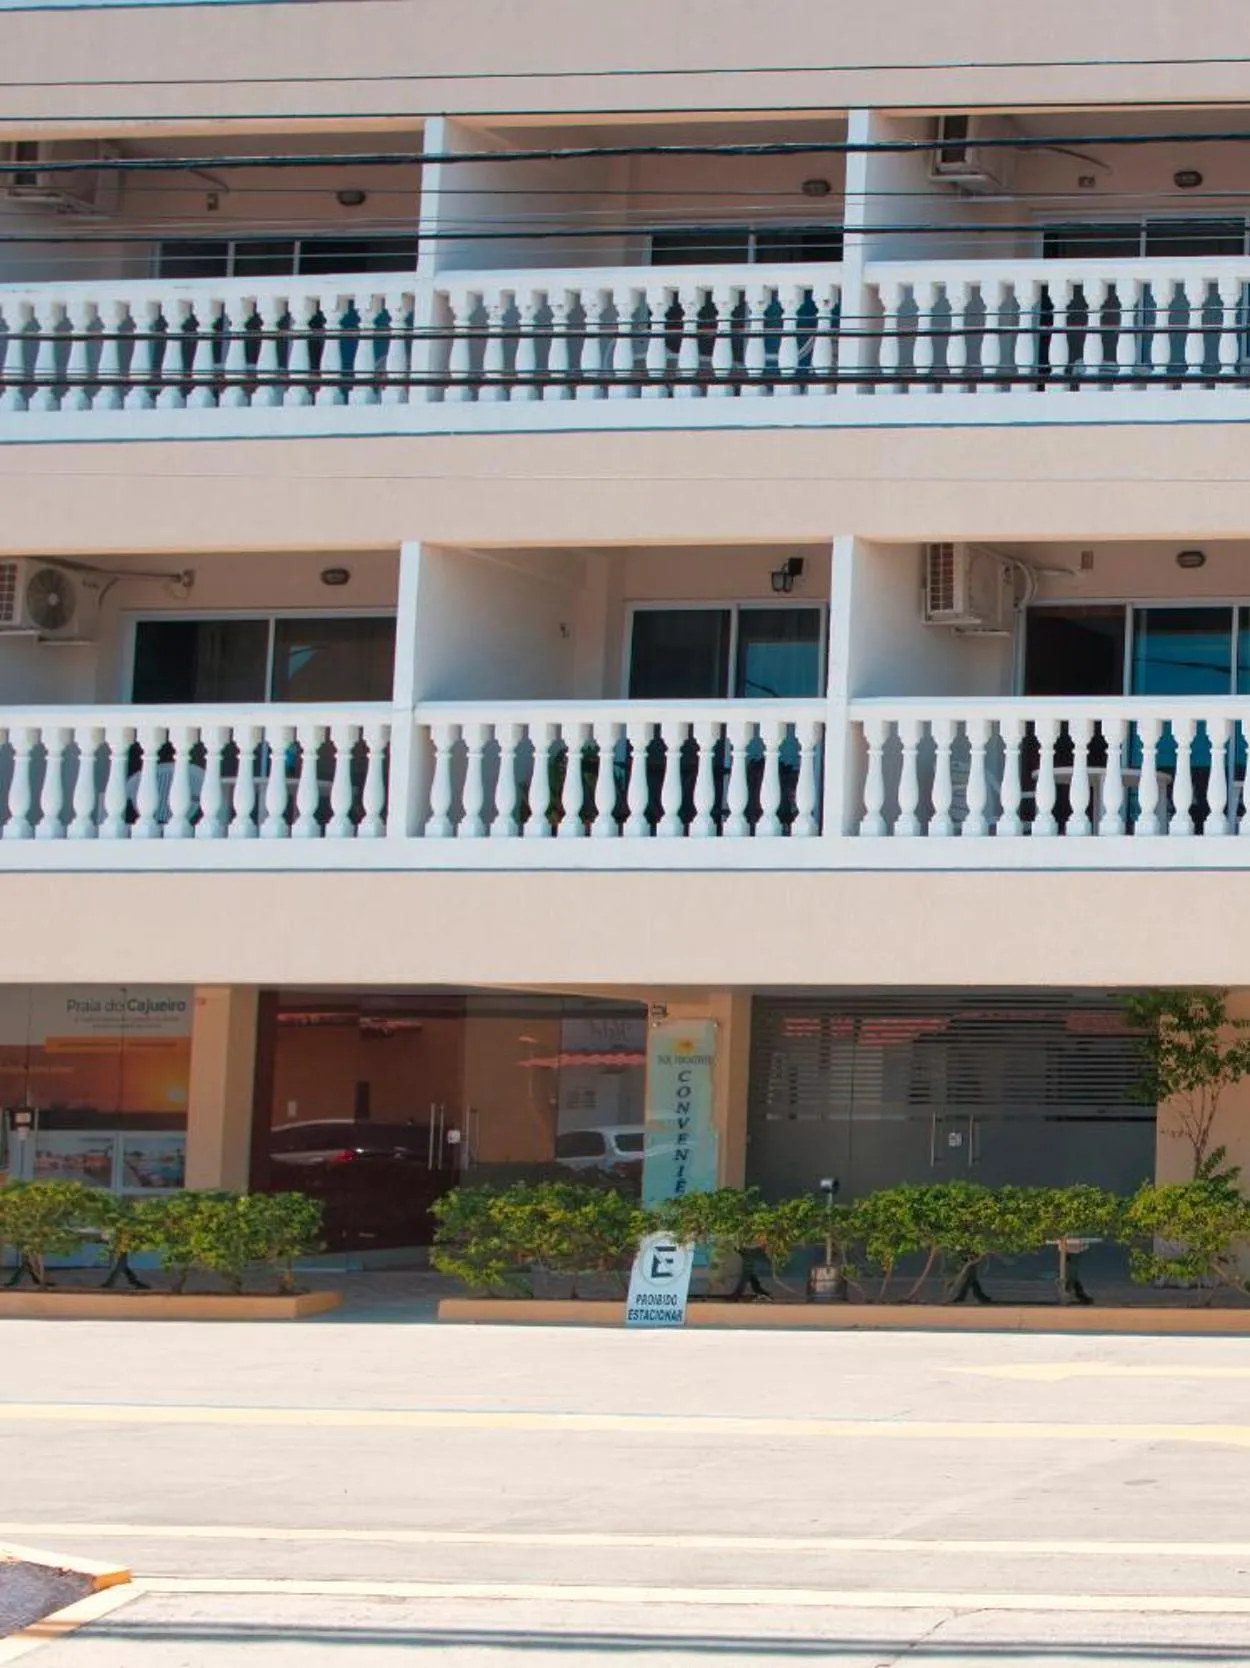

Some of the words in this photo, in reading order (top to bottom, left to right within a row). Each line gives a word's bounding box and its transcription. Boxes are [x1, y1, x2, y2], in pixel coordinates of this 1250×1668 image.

[66, 998, 102, 1012] Praia
[126, 998, 187, 1014] Cajueiro
[673, 1070, 692, 1193] CONVENIE
[636, 1293, 678, 1306] PROIBIDO
[628, 1308, 683, 1322] ESTACIONAR
